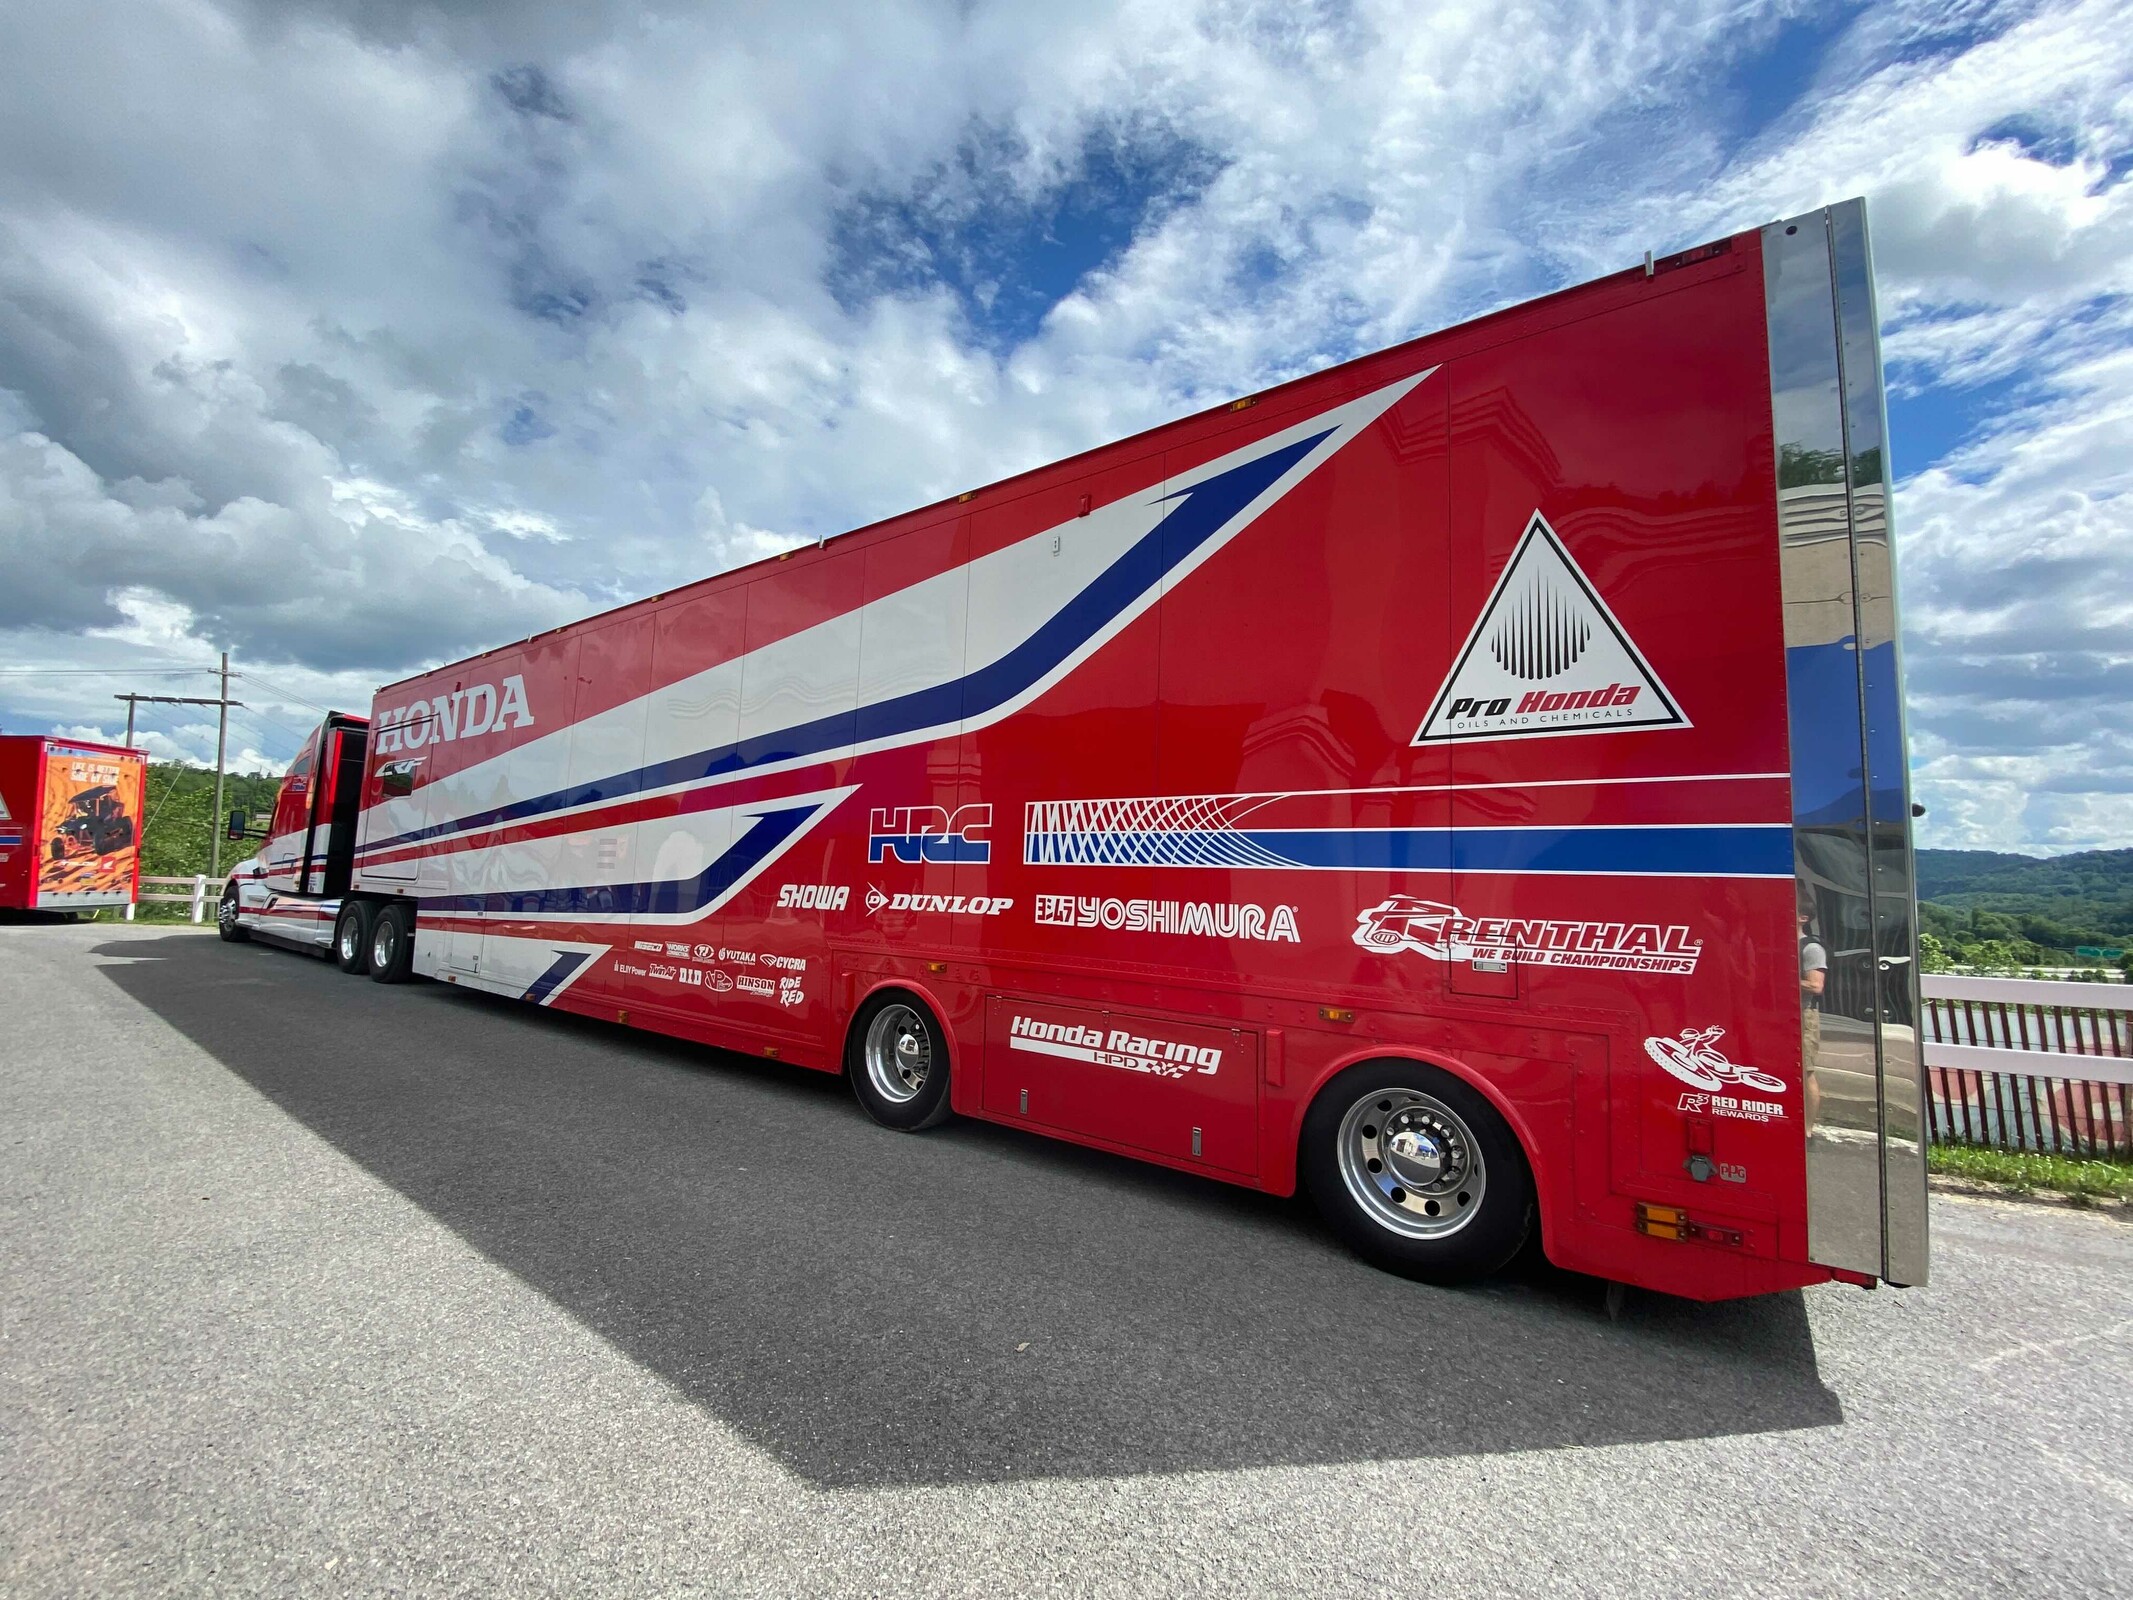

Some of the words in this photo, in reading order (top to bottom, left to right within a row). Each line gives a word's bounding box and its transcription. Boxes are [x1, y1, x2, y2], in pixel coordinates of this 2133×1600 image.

[1446, 697, 1511, 719] Pro
[1515, 683, 1641, 714] Honda
[375, 674, 534, 755] HONDA
[1457, 719, 1489, 729] OILS
[1499, 717, 1529, 726] AND
[1540, 708, 1633, 723] CHEMICALS
[868, 803, 993, 865] HRC
[777, 884, 850, 911] SHOWA
[888, 893, 1014, 916] DUNLOP
[1077, 896, 1301, 943] YOSHIMURA
[1440, 916, 1702, 956] RENTHAL
[726, 950, 756, 963] YUTAKA
[776, 956, 806, 971] CYCRA
[1472, 947, 1495, 960] WE
[1502, 950, 1545, 963] BUILD
[1550, 953, 1692, 973] CHAMPIONSHIPS
[738, 976, 775, 991] HINSON
[779, 976, 802, 990] RIDE
[780, 990, 804, 1007] RED
[1010, 1015, 1104, 1047] Honda
[1106, 1030, 1222, 1075] Racing
[1093, 1051, 1139, 1068] HPD
[1711, 1095, 1738, 1109] RED
[1742, 1099, 1784, 1115] RIDER
[1711, 1108, 1769, 1122] REWARDS
[1721, 1164, 1746, 1181] PPG
